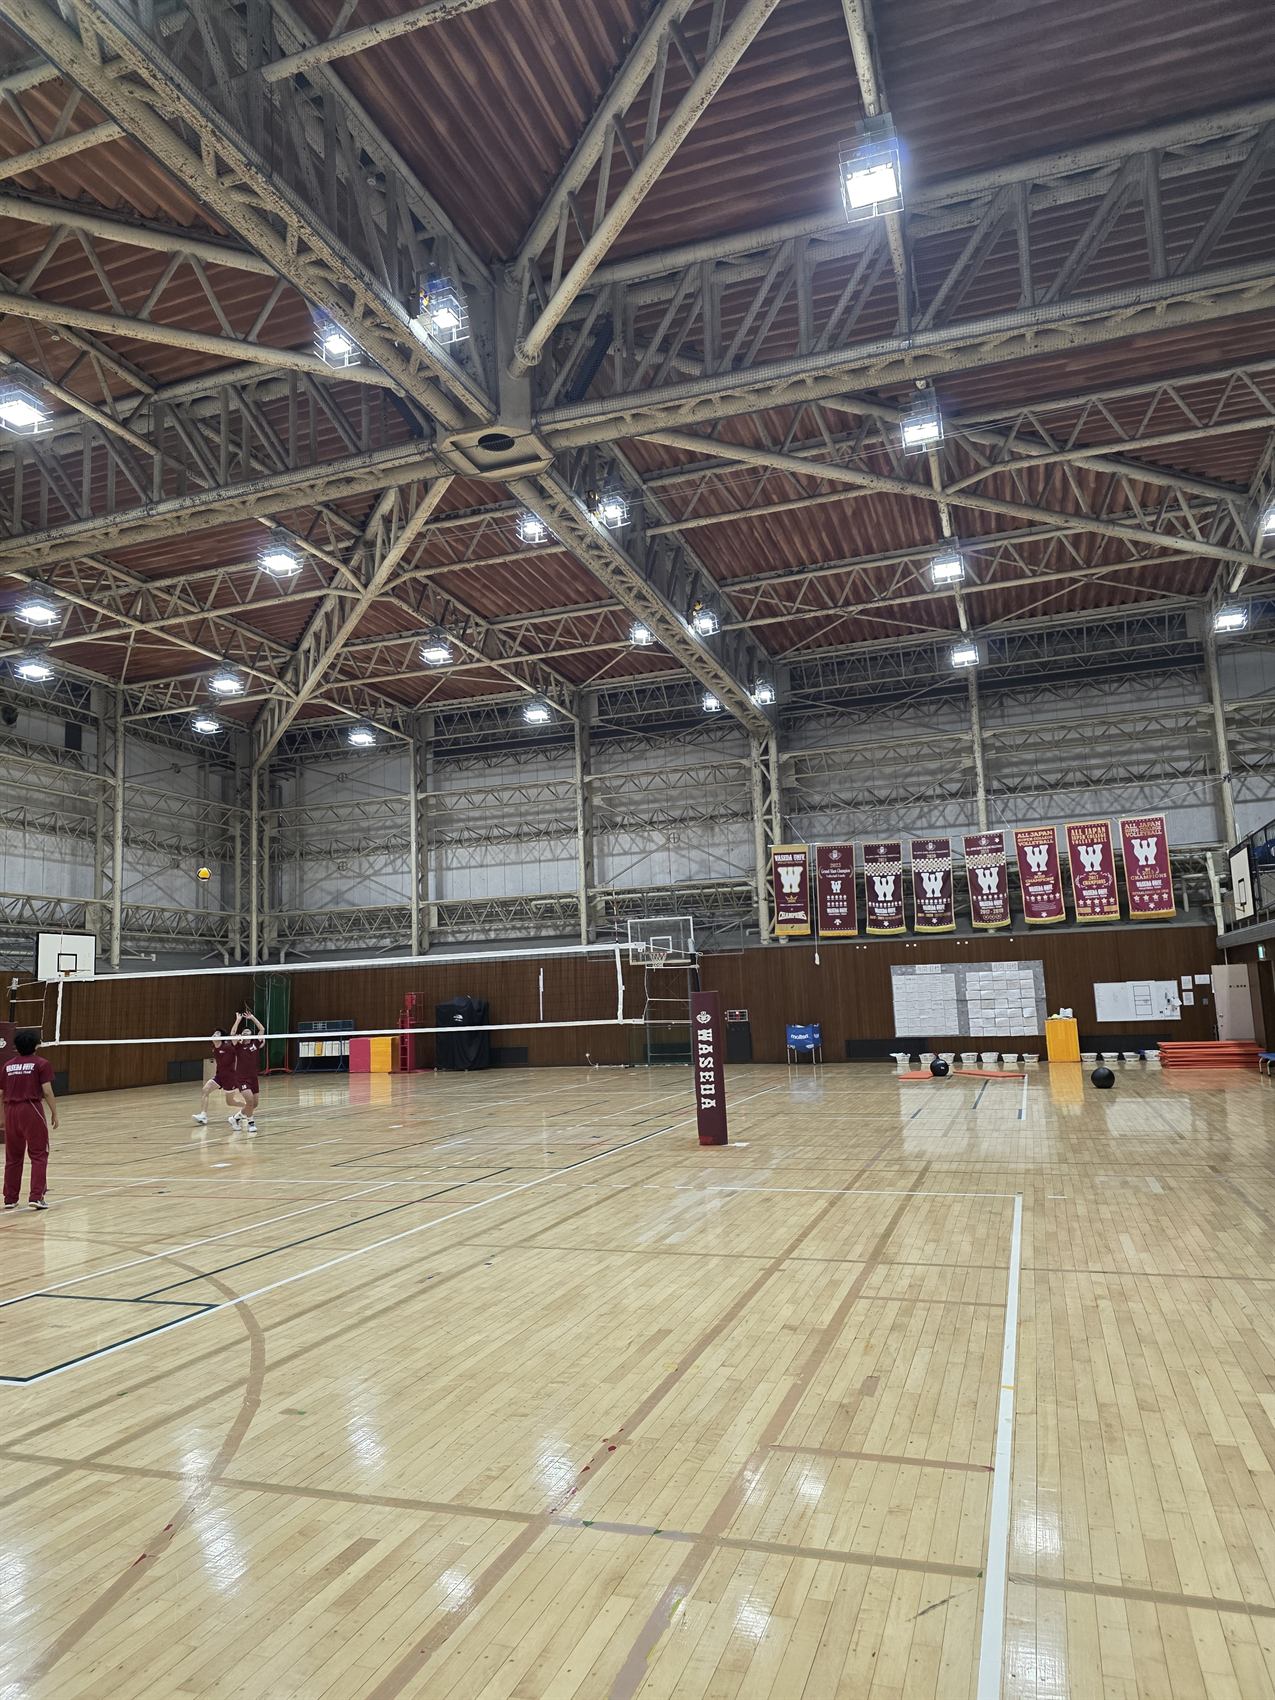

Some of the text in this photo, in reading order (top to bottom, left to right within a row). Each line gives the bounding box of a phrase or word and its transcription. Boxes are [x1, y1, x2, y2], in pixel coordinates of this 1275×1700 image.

[1024, 845, 1048, 872] W
[1078, 844, 1102, 872] W
[1131, 837, 1157, 865] W
[777, 866, 803, 893] W
[873, 876, 895, 901] W
[921, 872, 943, 897] W
[976, 867, 998, 894] W
[698, 1028, 716, 1109] WASEDA
